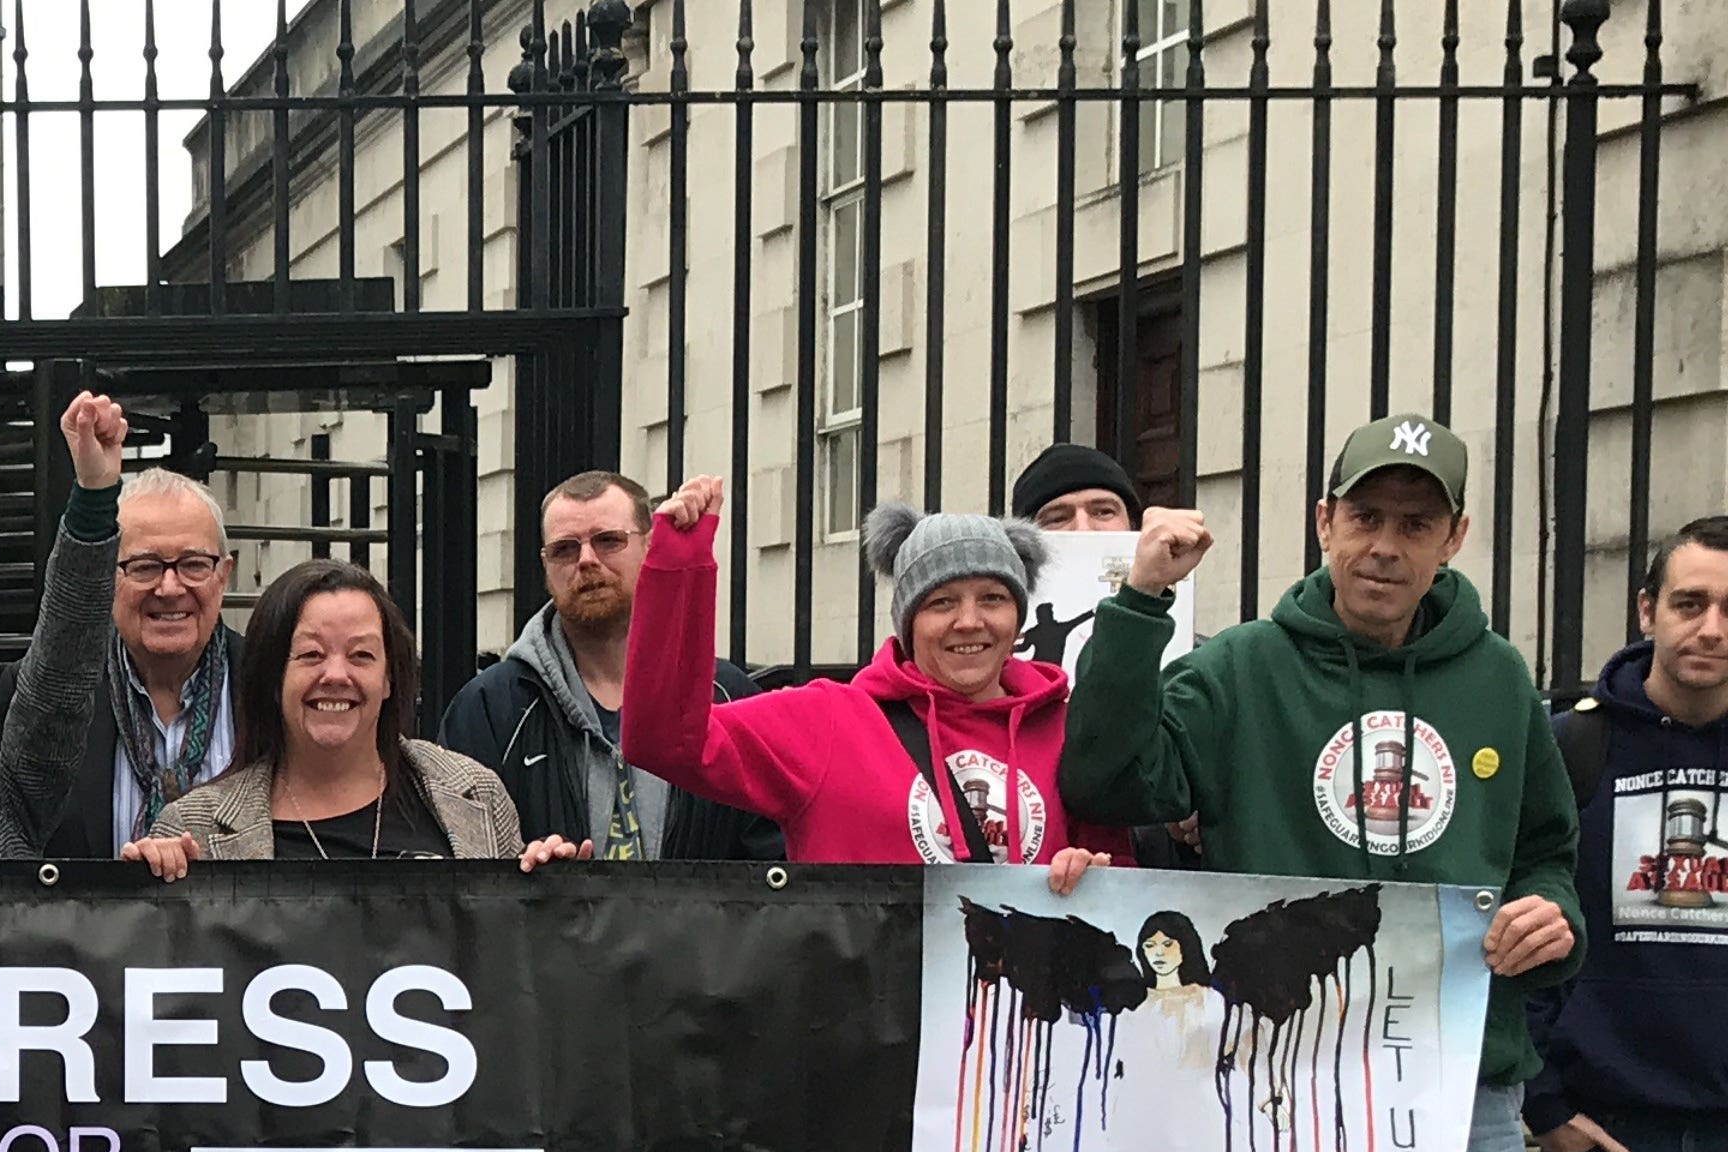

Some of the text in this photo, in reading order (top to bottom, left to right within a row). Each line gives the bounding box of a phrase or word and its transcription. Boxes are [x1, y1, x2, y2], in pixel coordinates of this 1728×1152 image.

[1318, 715, 1454, 784] NONC CATHERS NI
[1614, 769, 1664, 793] NONCE
[1029, 802, 1044, 820] NI
[1382, 966, 1415, 1082] LET
